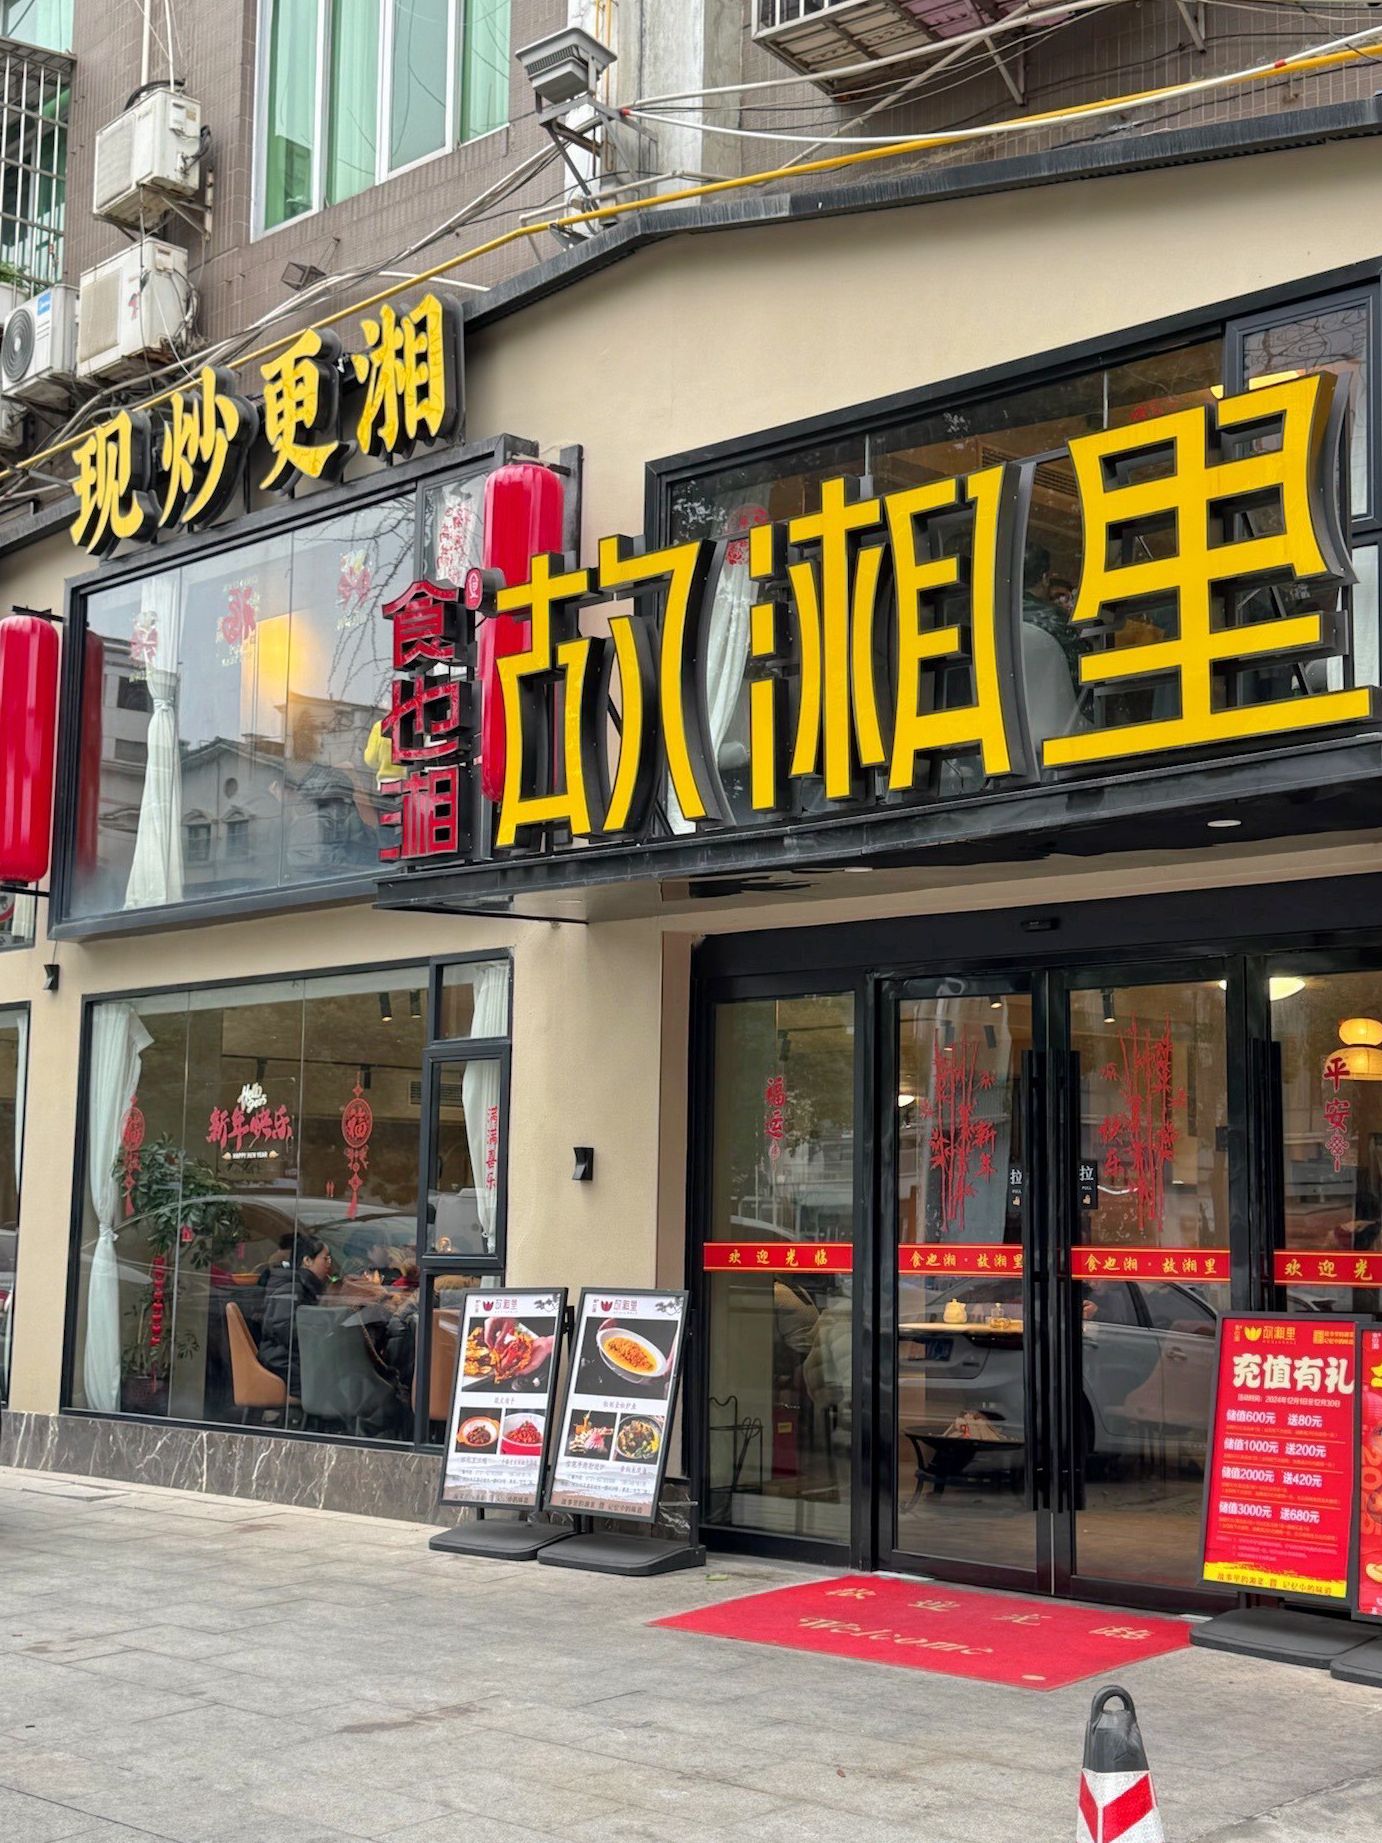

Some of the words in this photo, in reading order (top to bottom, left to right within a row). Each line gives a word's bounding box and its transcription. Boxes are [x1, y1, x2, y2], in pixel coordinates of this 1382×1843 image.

[71, 293, 447, 556] 现炒更湘
[379, 579, 461, 863] 食也湘
[1323, 1057, 1350, 1133] 平安
[206, 1104, 293, 1151] 新年快乐
[1009, 1168, 1023, 1185] 拉
[1080, 1164, 1094, 1182] 拉
[728, 1248, 828, 1267] 欢迎光临
[1233, 1353, 1355, 1395] 充值有礼
[1226, 1409, 1276, 1424] 储值600元
[1287, 1413, 1323, 1428] 送80元
[1223, 1437, 1279, 1454] 储值1000元
[1285, 1442, 1327, 1458] 送200元
[1221, 1466, 1275, 1483] 储值2000元
[1283, 1471, 1322, 1488] 送420元
[1219, 1501, 1273, 1519] 储值3000元
[1279, 1507, 1320, 1524] 送680元
[798, 1616, 994, 1656] Welcome
